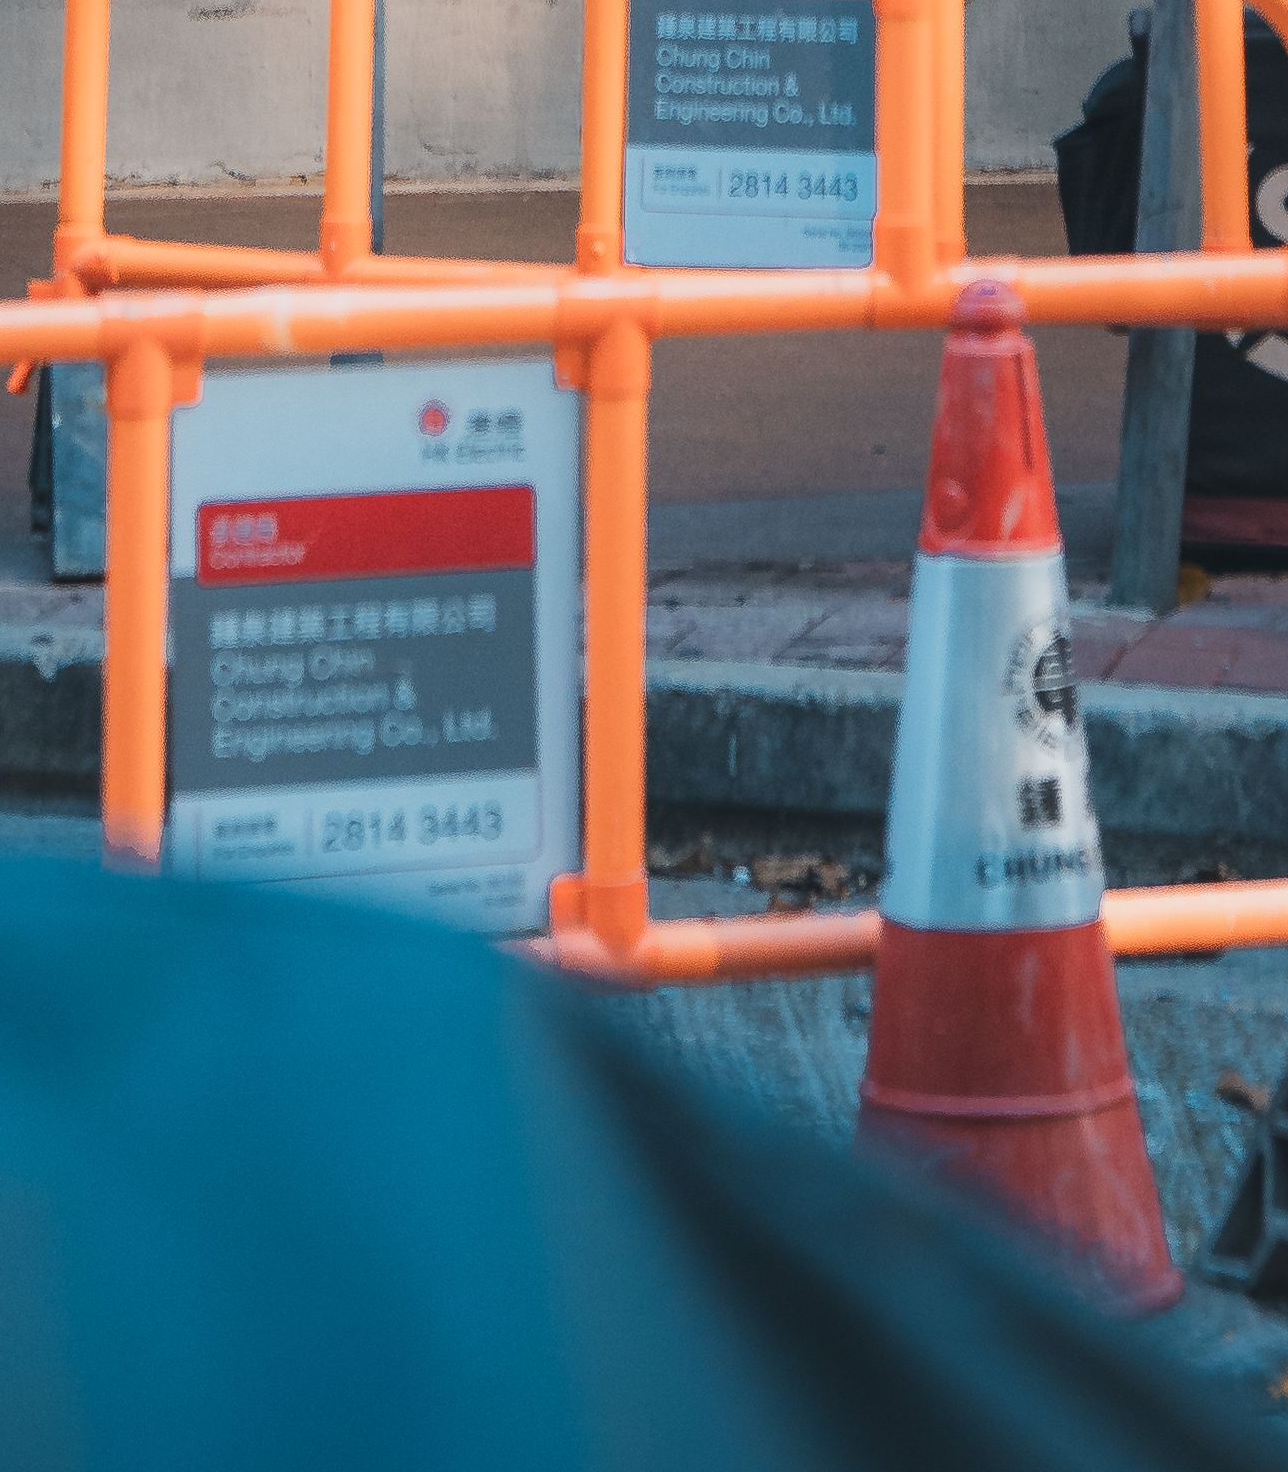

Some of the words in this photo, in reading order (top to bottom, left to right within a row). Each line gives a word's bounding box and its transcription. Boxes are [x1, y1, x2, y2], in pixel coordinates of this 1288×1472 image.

[656, 45, 722, 72] Chung
[726, 46, 771, 69] Chin
[655, 73, 779, 96] Construction
[784, 72, 799, 97] &
[654, 98, 769, 127] Engineering
[728, 169, 788, 199] 2814
[798, 171, 858, 202] 3443
[212, 683, 389, 722] Construction
[212, 716, 378, 761] Engineering
[322, 805, 407, 854] 2814
[417, 799, 504, 845] 3443
